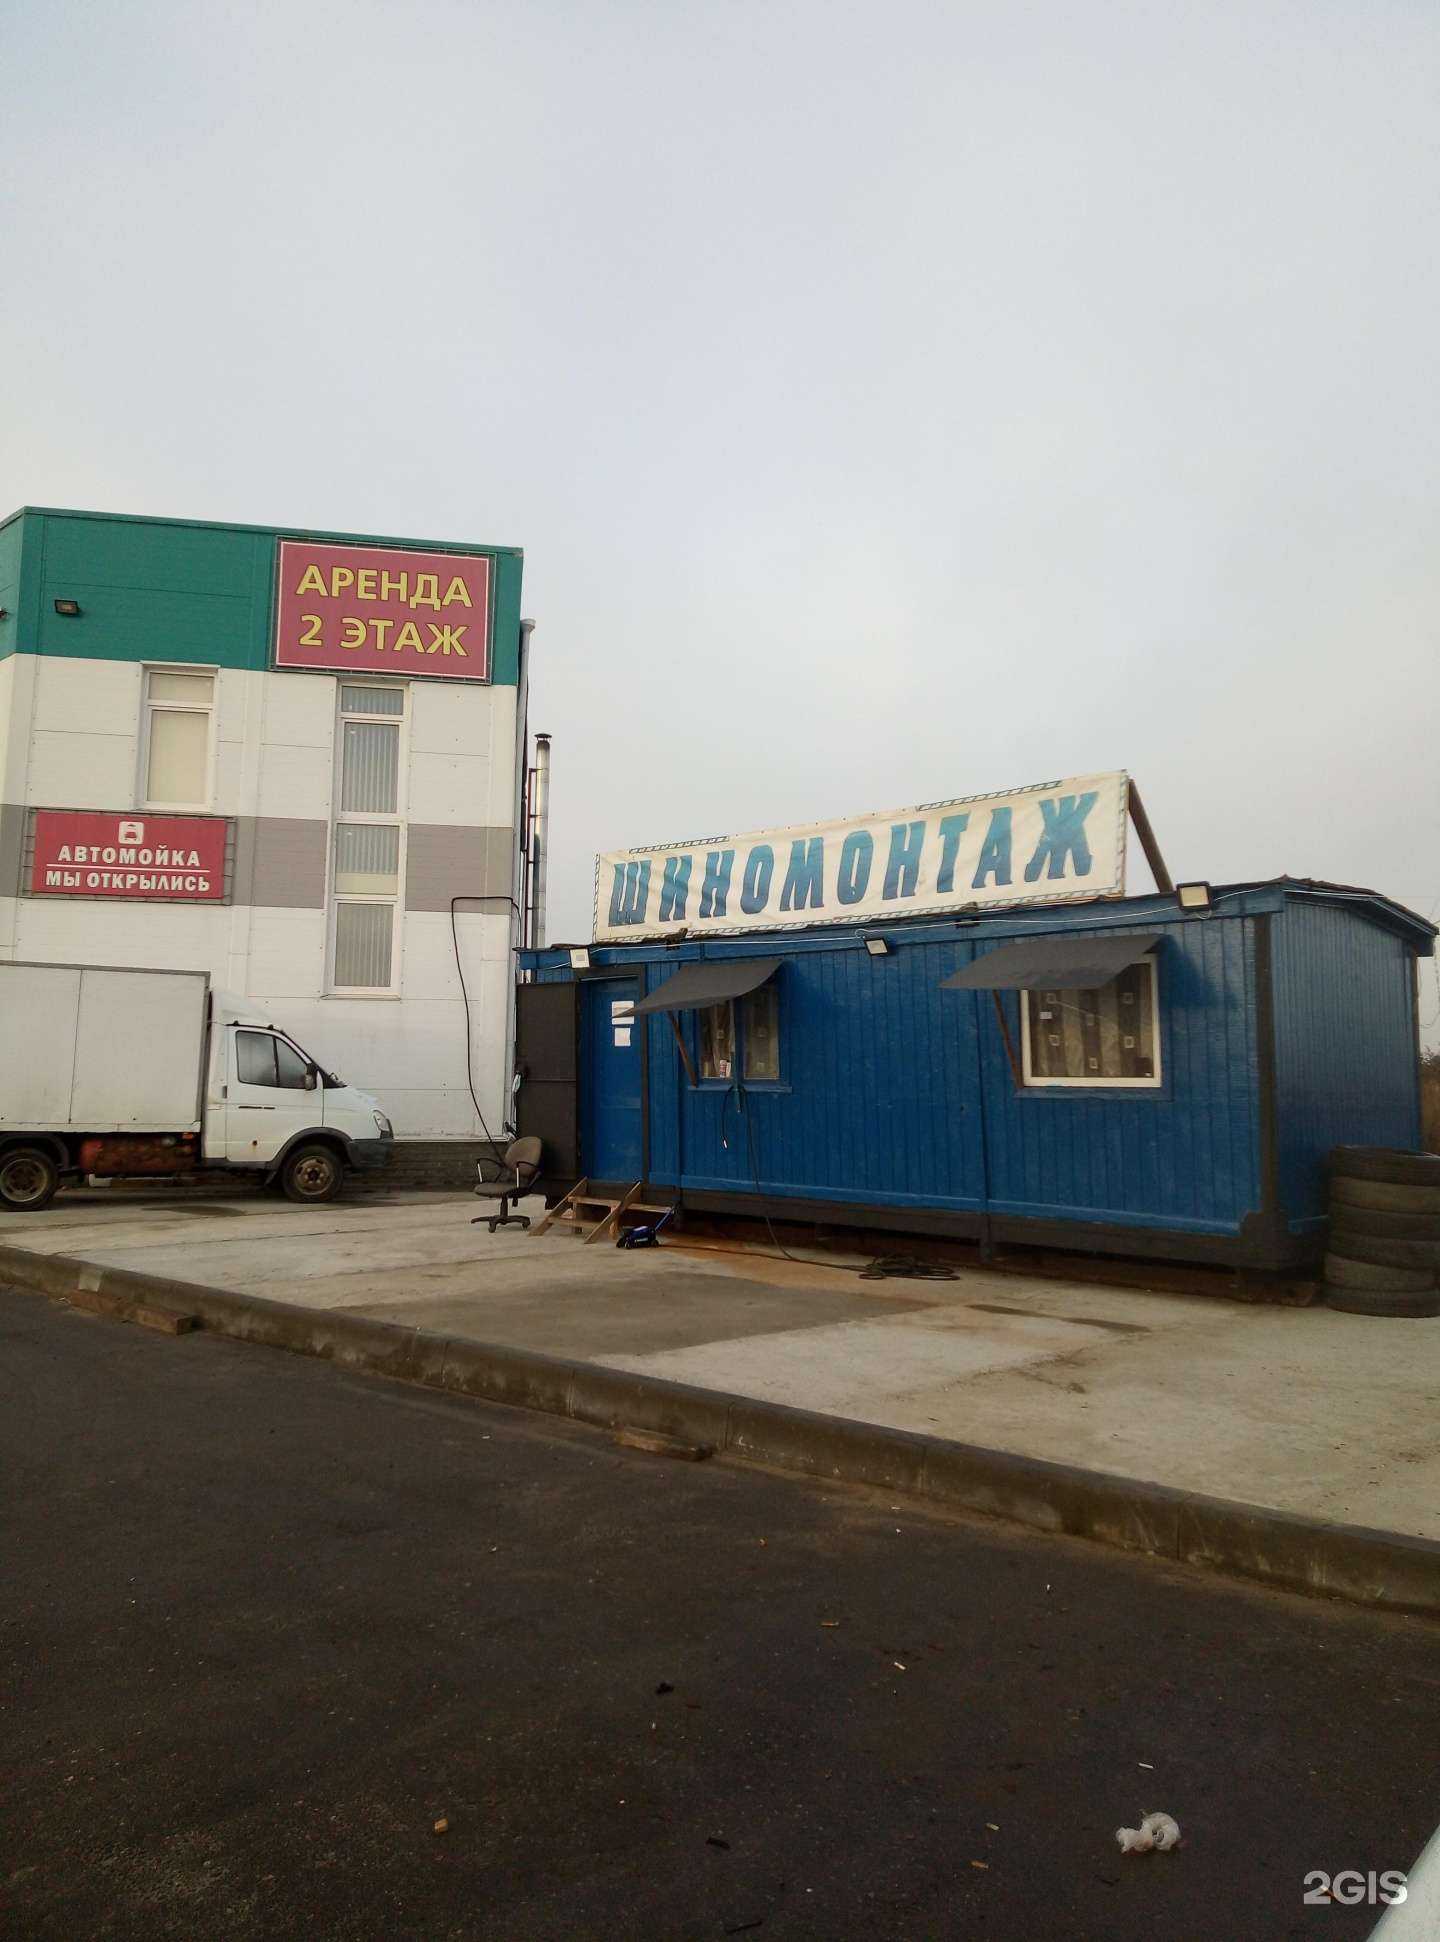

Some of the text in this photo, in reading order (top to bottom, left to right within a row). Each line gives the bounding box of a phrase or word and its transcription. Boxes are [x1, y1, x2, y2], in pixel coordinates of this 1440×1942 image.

[296, 563, 473, 611] АРЕНДА
[299, 614, 471, 657] 2 ЭТАЖ
[57, 844, 201, 867] АВТОМОЙКА
[607, 791, 1100, 928] ШИНОМОНТАЖ
[45, 870, 211, 892] МЫ ОТКРЫЛИСЬ
